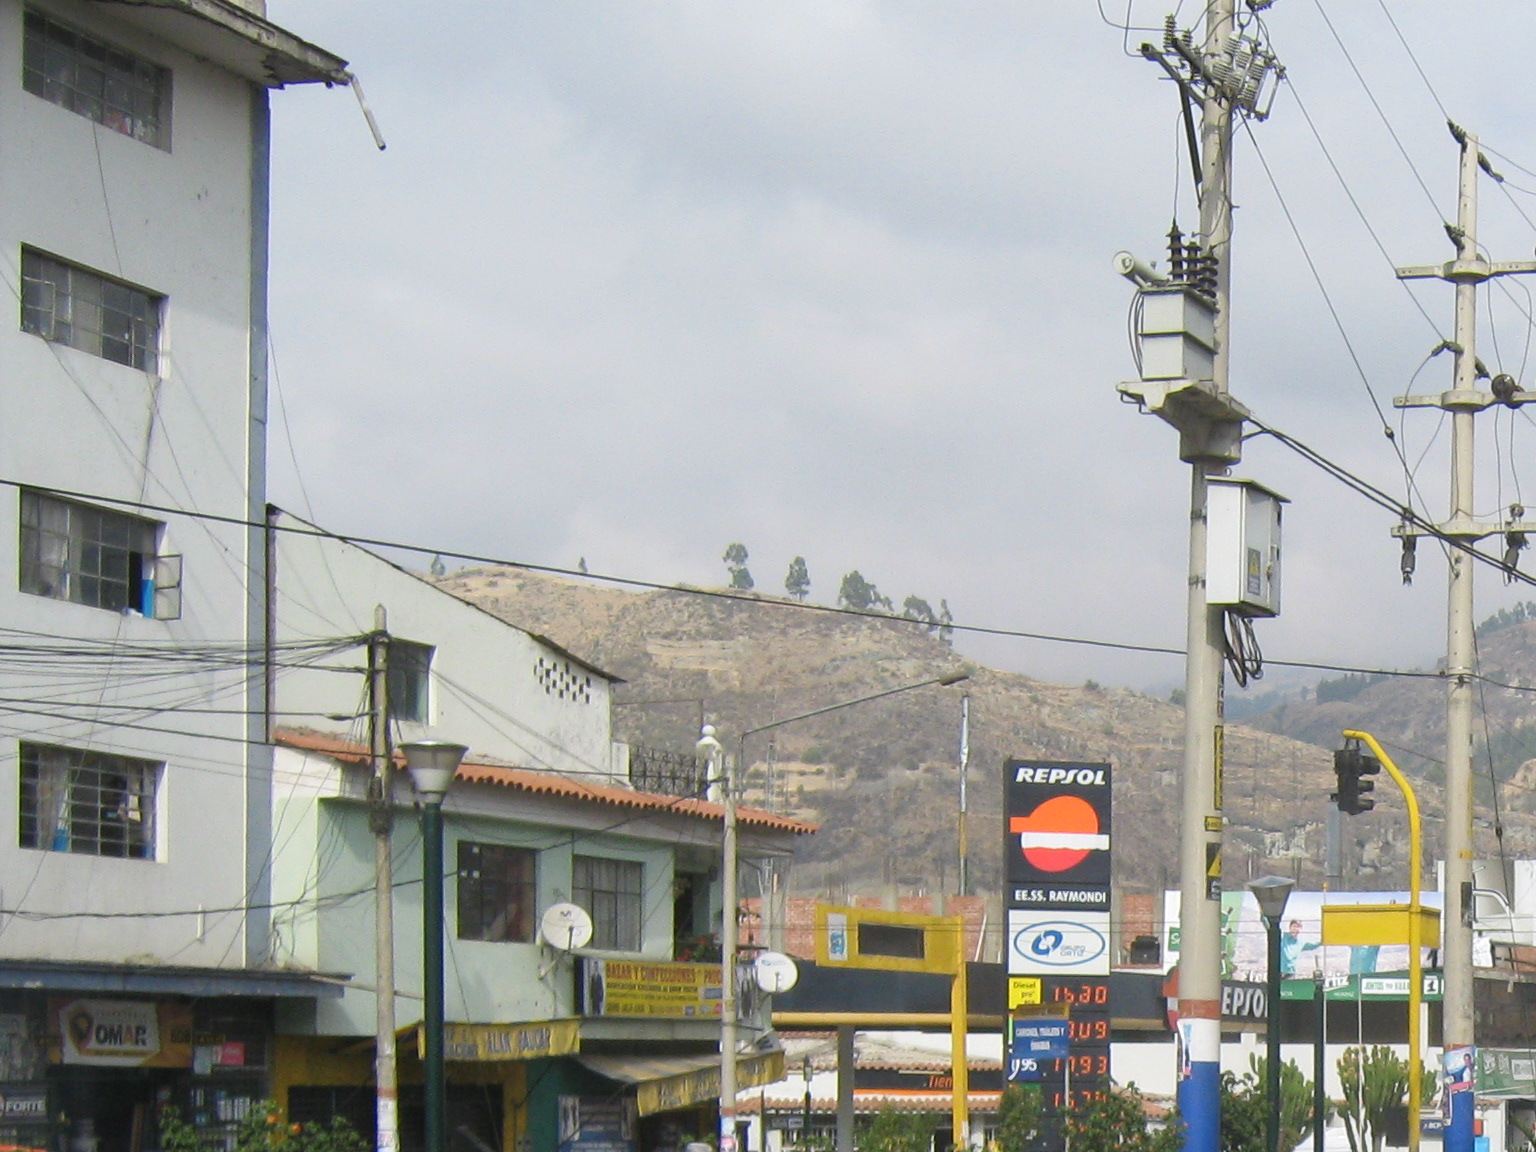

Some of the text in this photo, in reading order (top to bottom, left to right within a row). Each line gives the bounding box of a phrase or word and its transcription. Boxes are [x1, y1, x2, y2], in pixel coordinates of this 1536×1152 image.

[1016, 767, 1106, 785] REPSOL
[1049, 890, 1106, 903] RAYMONDI
[1013, 981, 1036, 989] Diesel
[1221, 985, 1268, 1018] EPSO
[95, 1022, 147, 1047] OMAR
